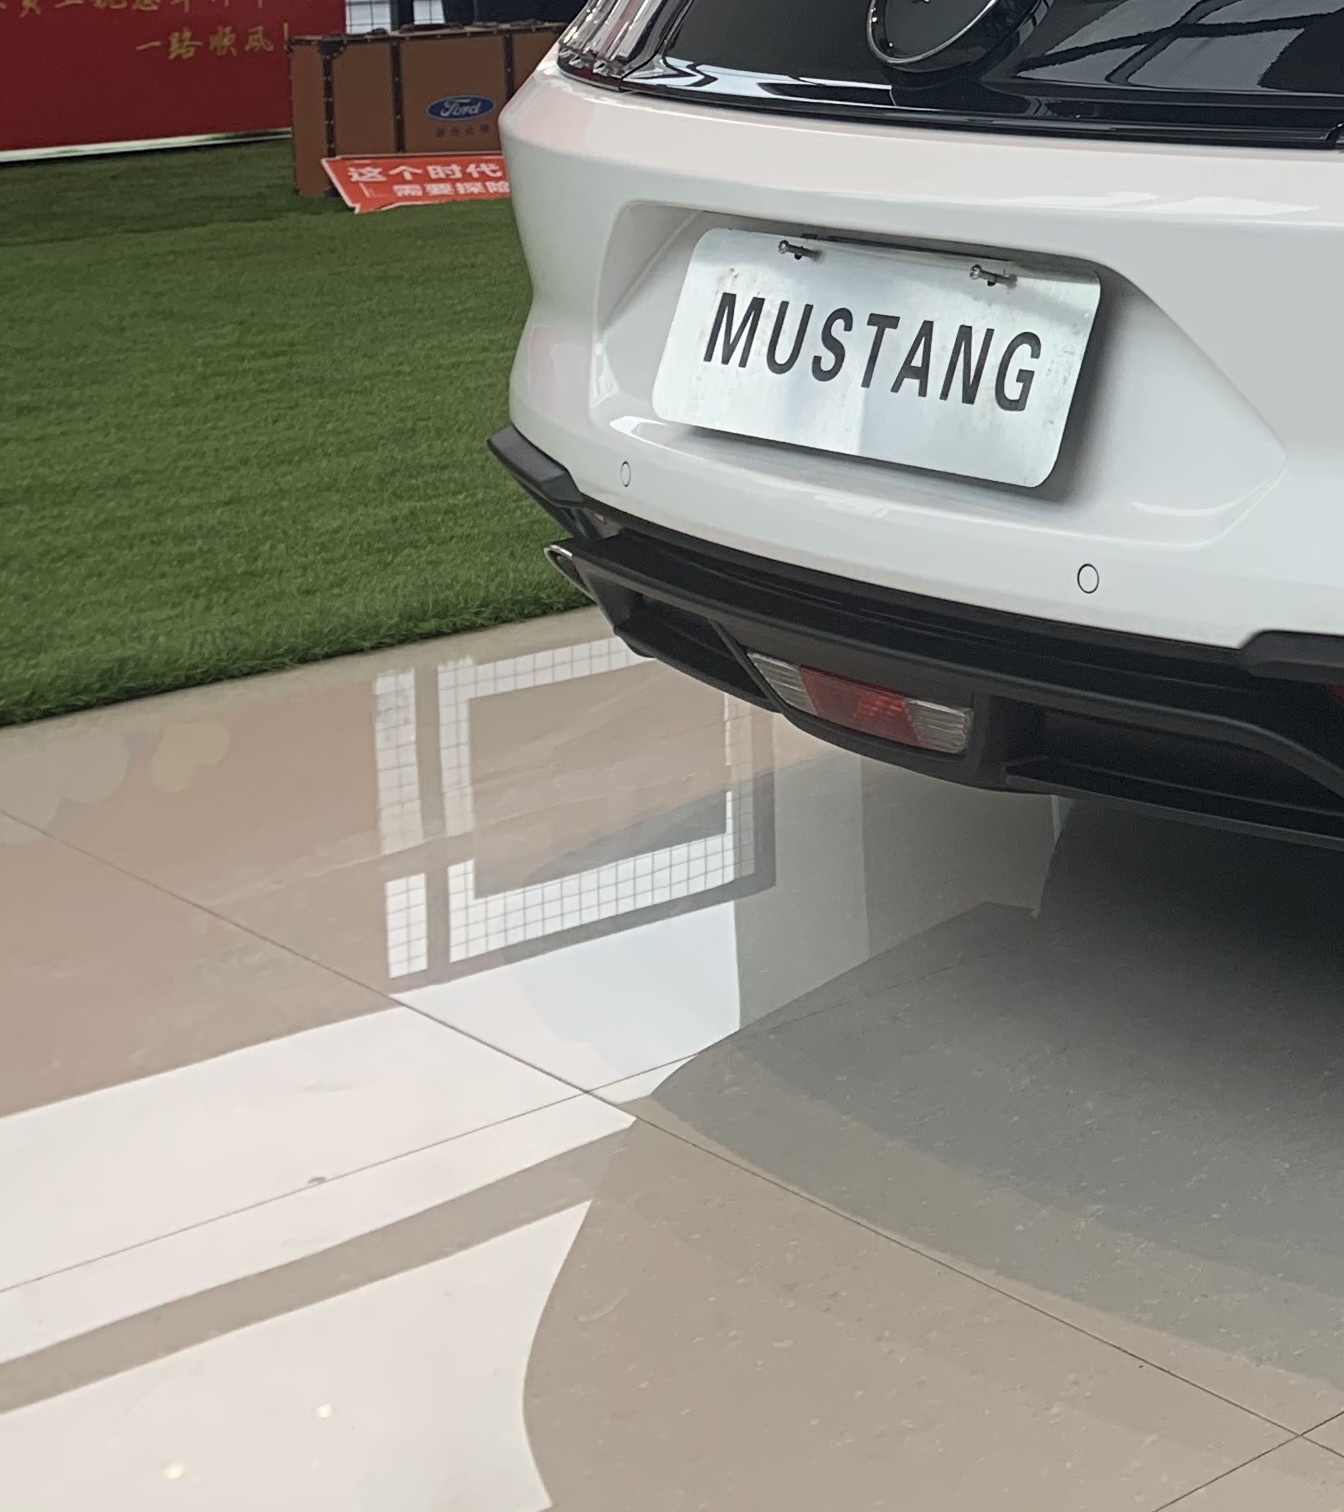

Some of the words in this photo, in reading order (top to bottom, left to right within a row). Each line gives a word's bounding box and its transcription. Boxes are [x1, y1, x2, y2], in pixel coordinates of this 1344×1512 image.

[439, 98, 483, 118] Ford
[347, 162, 503, 183] 这个时代
[703, 291, 1042, 412] MUSTANG
